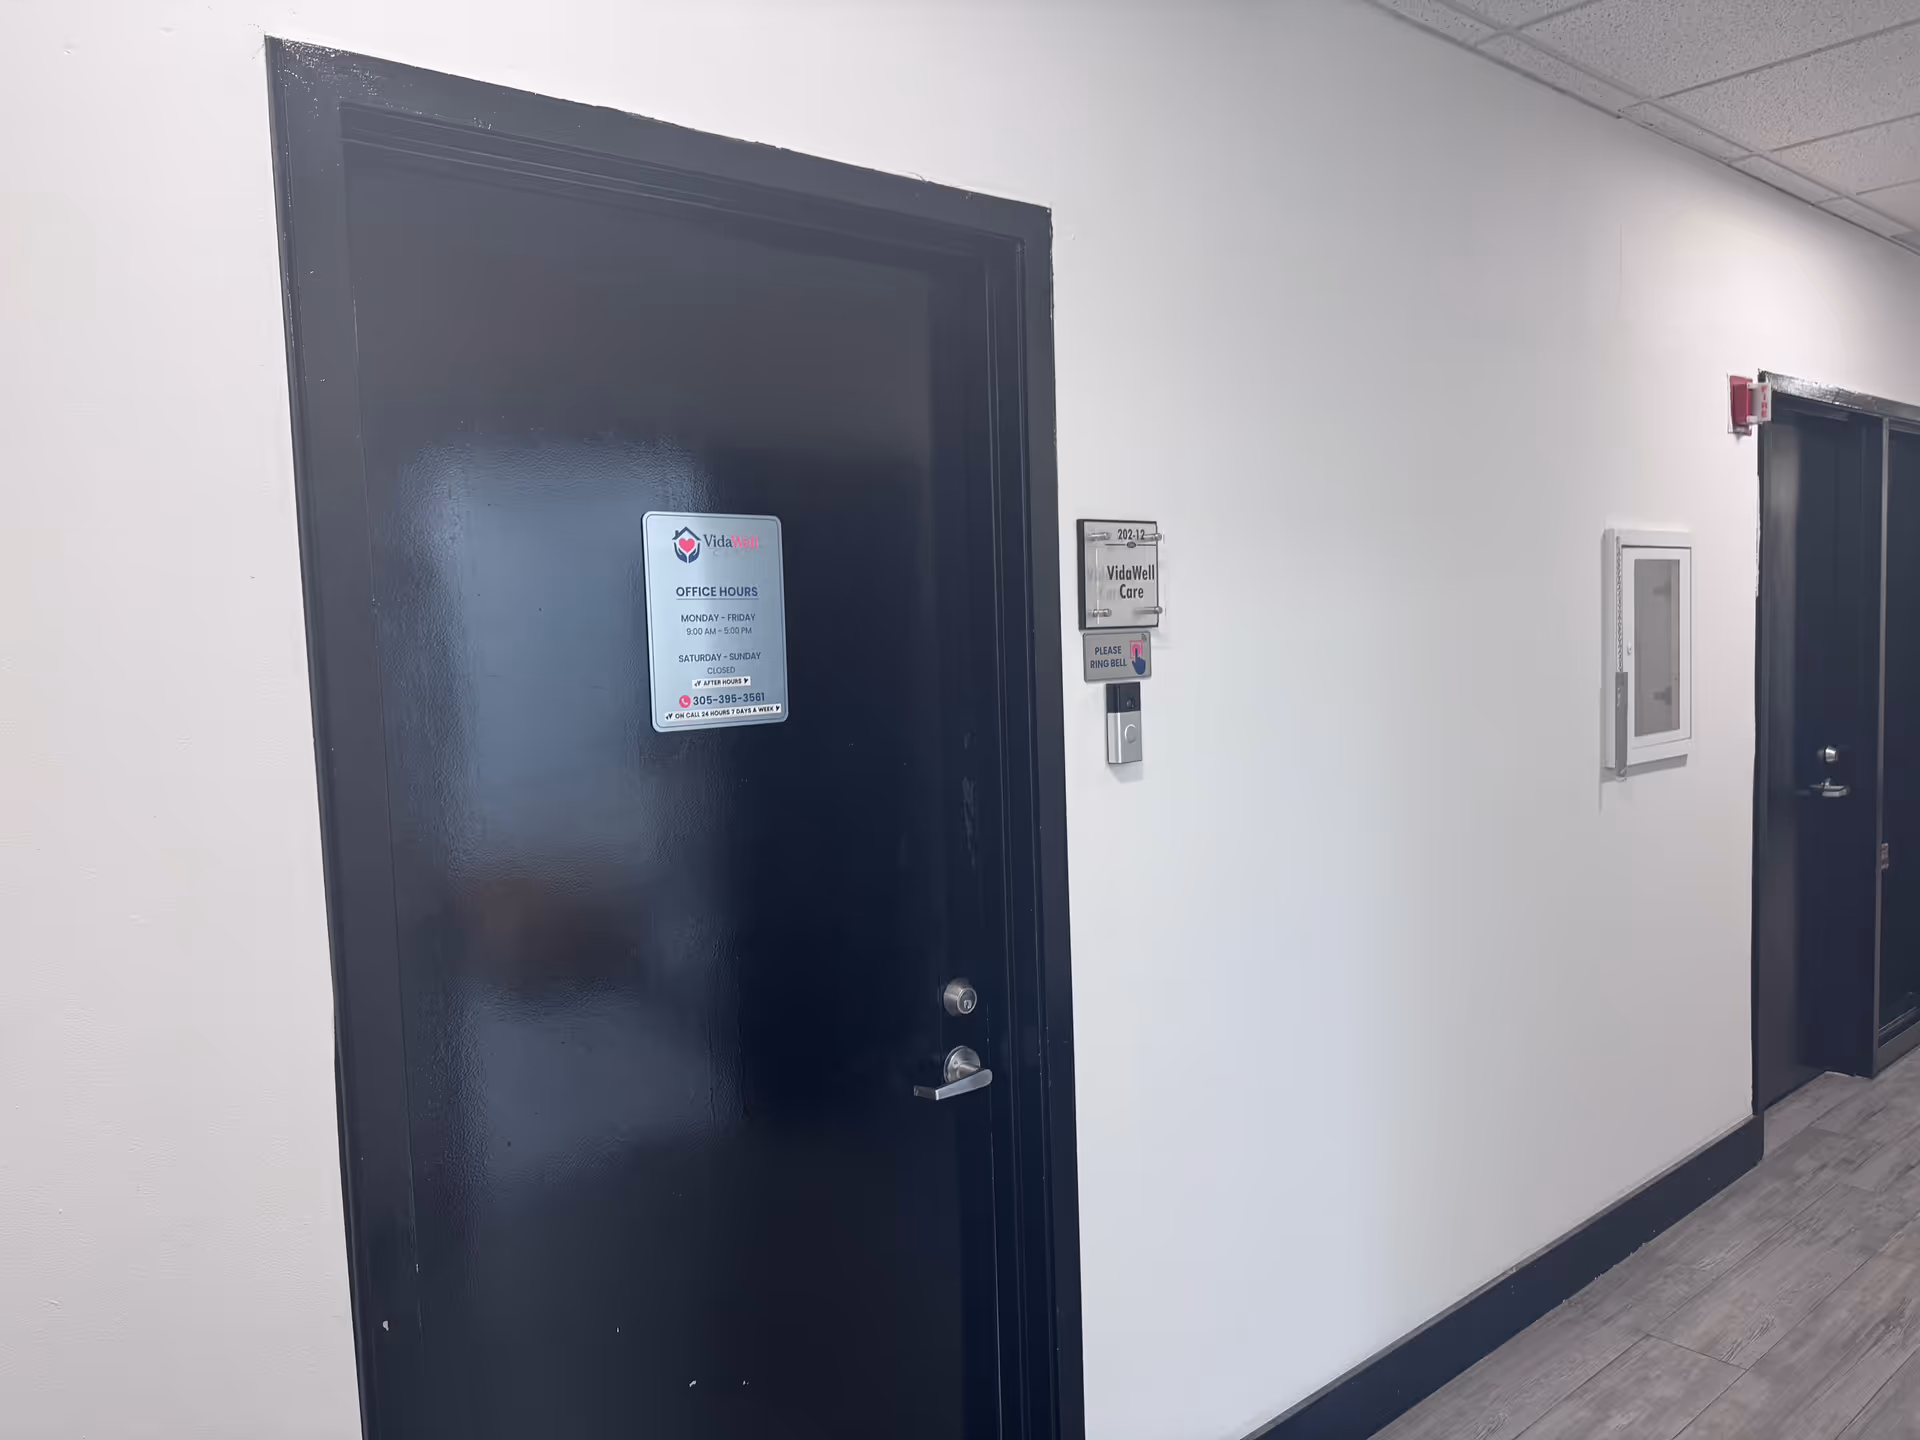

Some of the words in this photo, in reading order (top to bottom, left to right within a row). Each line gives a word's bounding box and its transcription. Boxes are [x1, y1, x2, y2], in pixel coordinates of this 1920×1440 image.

[1761, 384, 1769, 418] FIRE
[1117, 528, 1145, 541] 202-12
[703, 534, 758, 549] VidaWell
[1106, 564, 1155, 581] VidaWell
[676, 586, 717, 597] OFFICE
[719, 587, 758, 597] HOURS
[1119, 583, 1144, 599] Care
[681, 614, 719, 623] MONDAY
[727, 613, 756, 622] FRIDAY
[686, 628, 703, 636] 9:00
[704, 627, 717, 635] AM
[724, 627, 740, 635] 5:00
[1094, 645, 1122, 655] PLEASE
[678, 653, 722, 663] SATURDAY
[729, 652, 761, 660] SUNDAY
[1090, 659, 1110, 669] RING
[1110, 658, 1127, 668] BELL
[707, 666, 736, 675] CLOSED
[703, 679, 721, 687] AFTER
[693, 692, 765, 706] 305-395-3561
